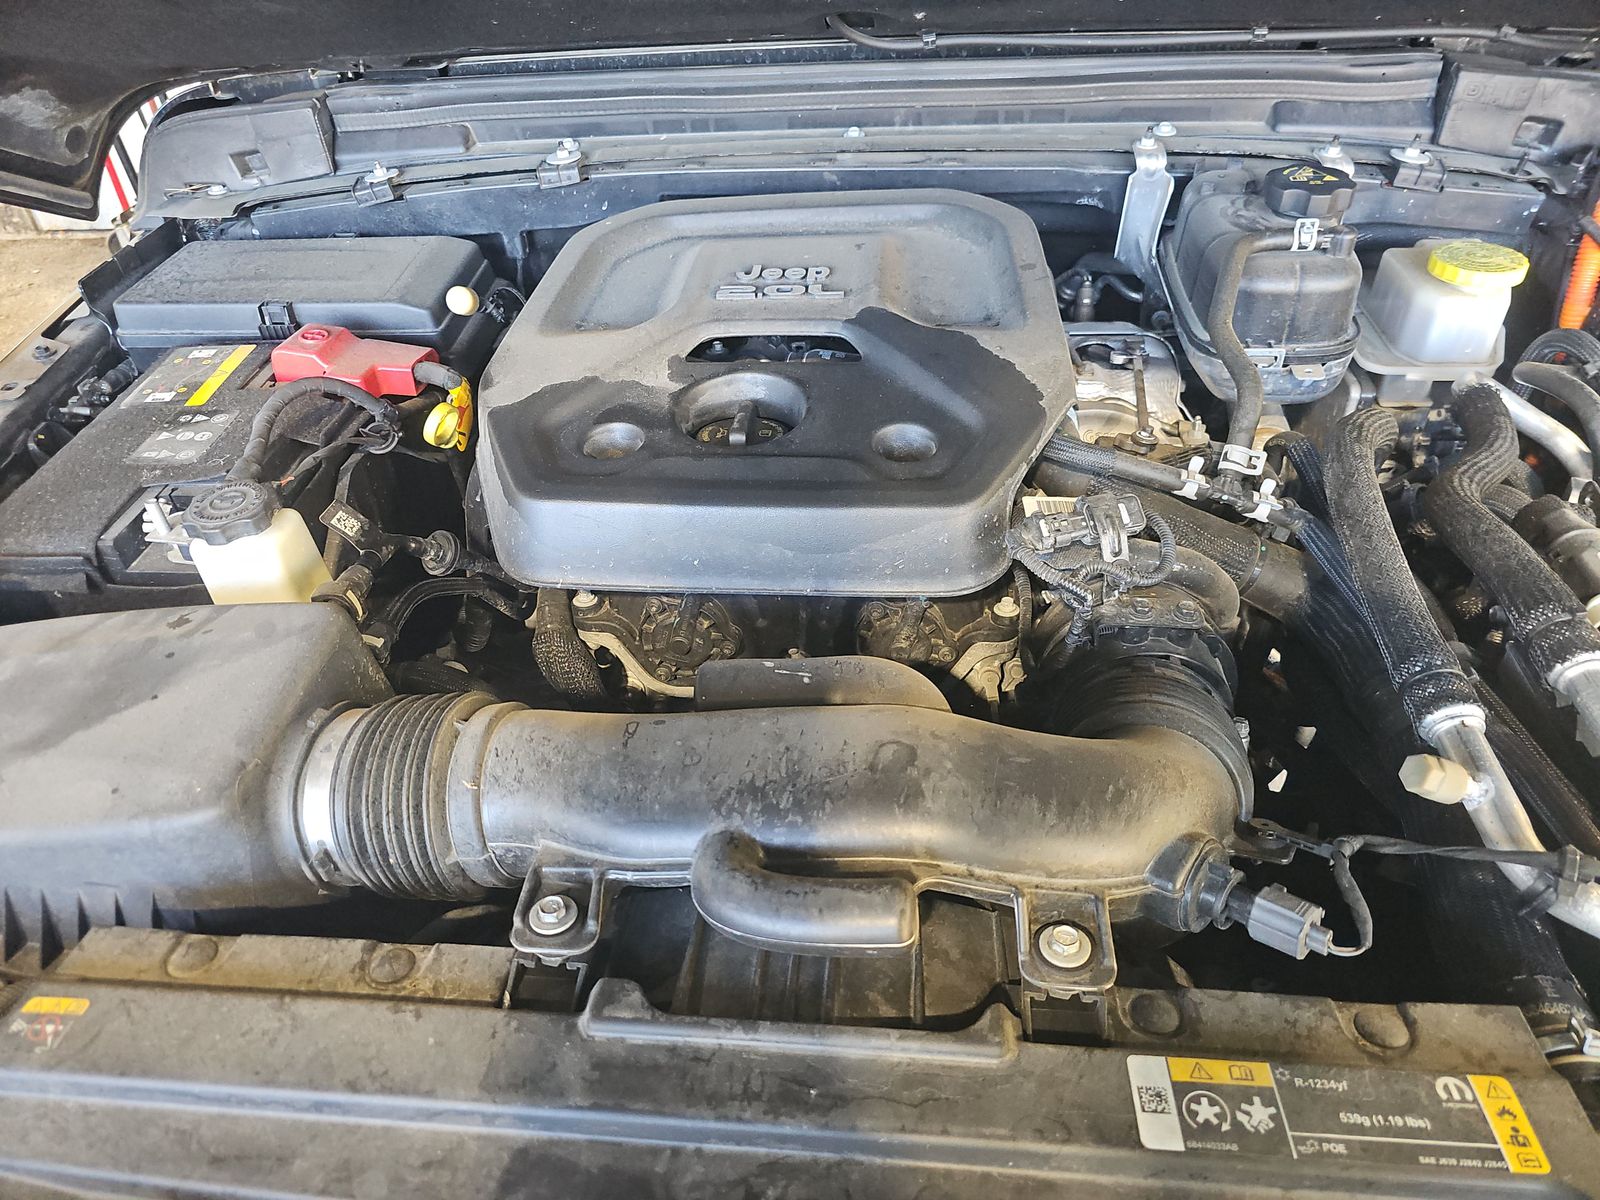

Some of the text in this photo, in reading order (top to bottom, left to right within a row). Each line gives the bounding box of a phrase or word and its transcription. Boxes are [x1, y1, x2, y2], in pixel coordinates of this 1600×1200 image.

[735, 264, 831, 283] Jeep
[715, 284, 846, 301] 2.0L
[1294, 1077, 1348, 1092] R-1234yf
[1321, 1142, 1348, 1155] POE
